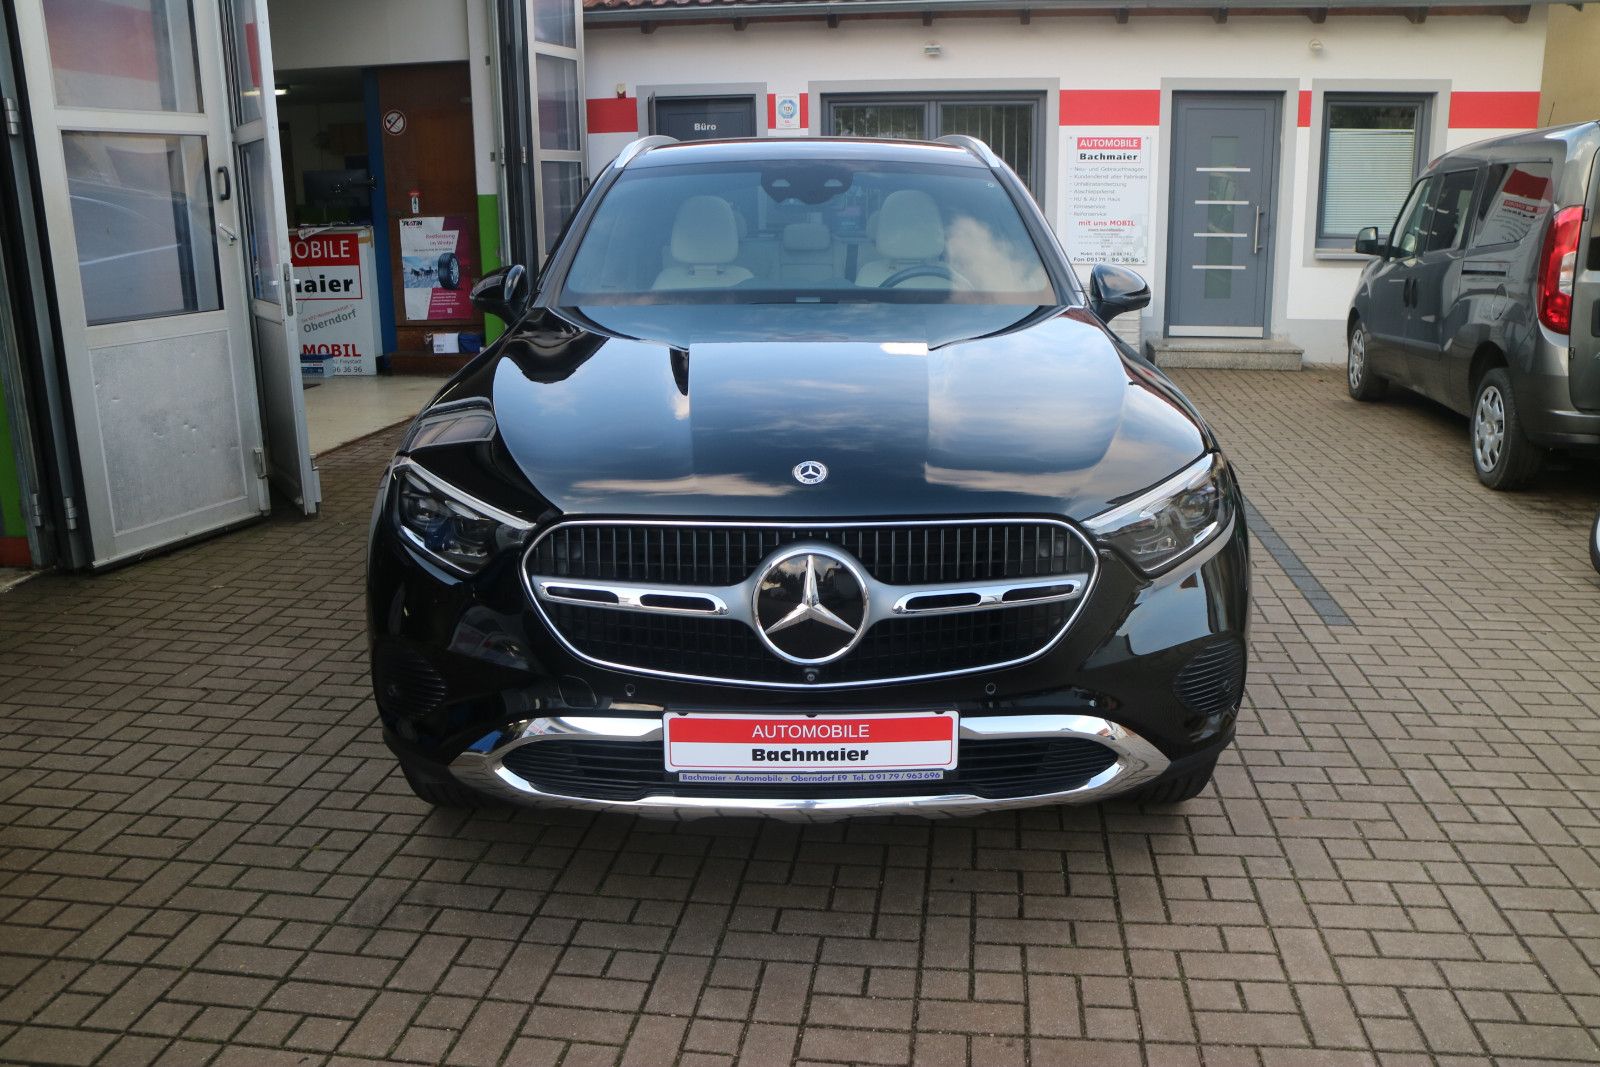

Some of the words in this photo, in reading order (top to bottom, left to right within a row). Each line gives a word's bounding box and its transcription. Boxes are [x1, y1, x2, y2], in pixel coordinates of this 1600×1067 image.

[694, 123, 717, 131] Büro
[1080, 139, 1138, 147] AUTOMOBILE
[303, 309, 357, 333] Oberndorf
[303, 344, 361, 357] MOBIL
[752, 725, 869, 738] AUTOMOBILE
[752, 748, 868, 763] Bachmaier
[735, 774, 782, 782] Automobile
